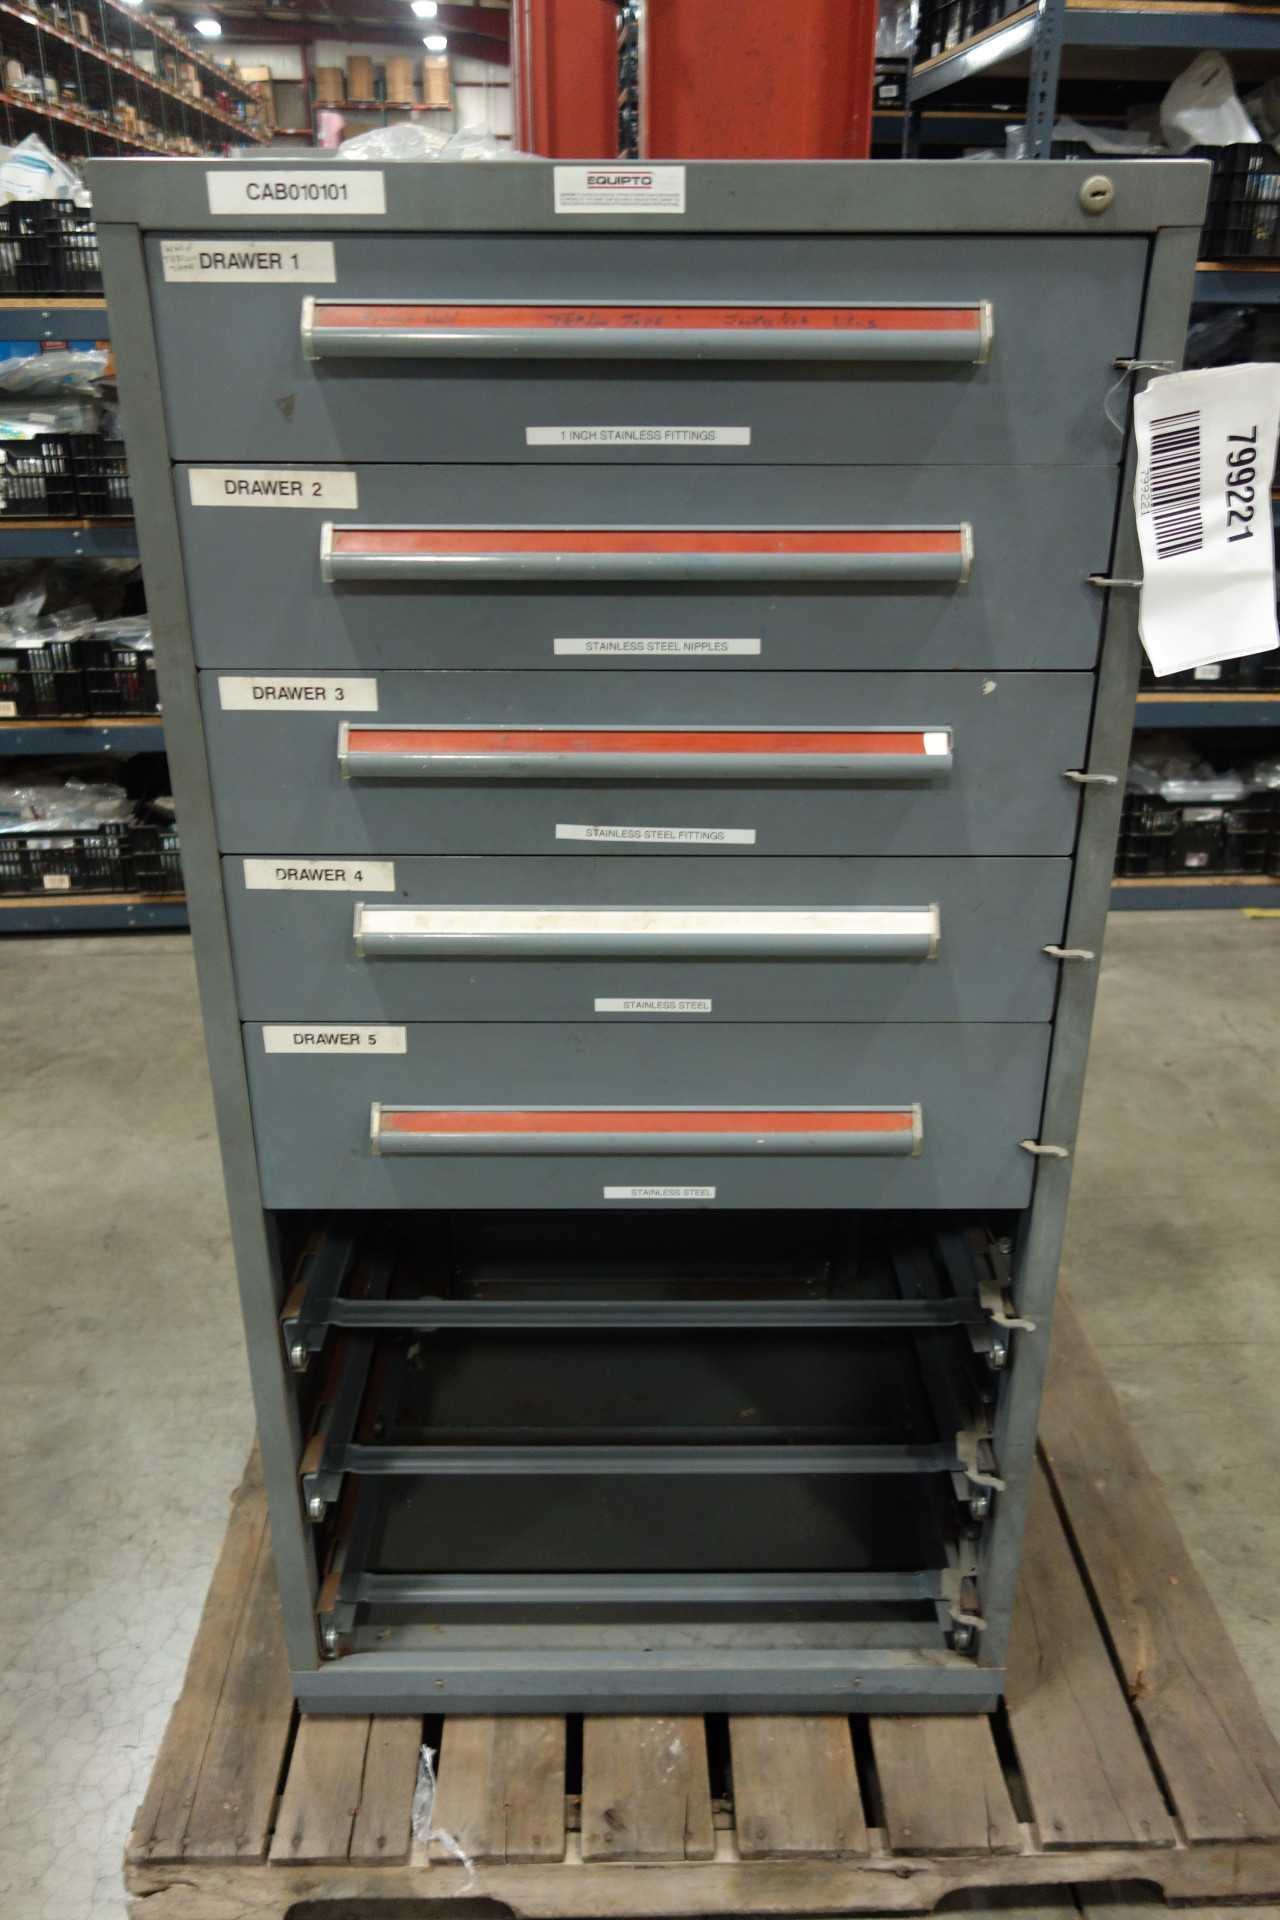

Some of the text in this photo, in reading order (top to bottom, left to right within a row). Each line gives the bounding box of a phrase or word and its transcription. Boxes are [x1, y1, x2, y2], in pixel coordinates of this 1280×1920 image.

[586, 175, 653, 186] EQUIPTO
[246, 182, 348, 201] CAB010101
[199, 252, 283, 270] DRAWER
[290, 253, 299, 270] 1
[569, 430, 597, 442] INCH
[599, 430, 662, 443] STAINLESS
[664, 430, 716, 443] FITTINGS
[223, 479, 323, 497] DRAWER 2
[1225, 425, 1258, 543] 799221
[585, 641, 729, 653] STAINLESS STEEL NIPPLES
[252, 686, 346, 701] DRAWER 3
[584, 828, 725, 842] STAINLESS STEEL FITTINGS
[275, 867, 364, 882] DRAWER 4
[622, 1000, 710, 1011] STAINLESS STEEL
[293, 1033, 377, 1046] DRAWER 5
[630, 1188, 713, 1198] STAINLESS STEEL
